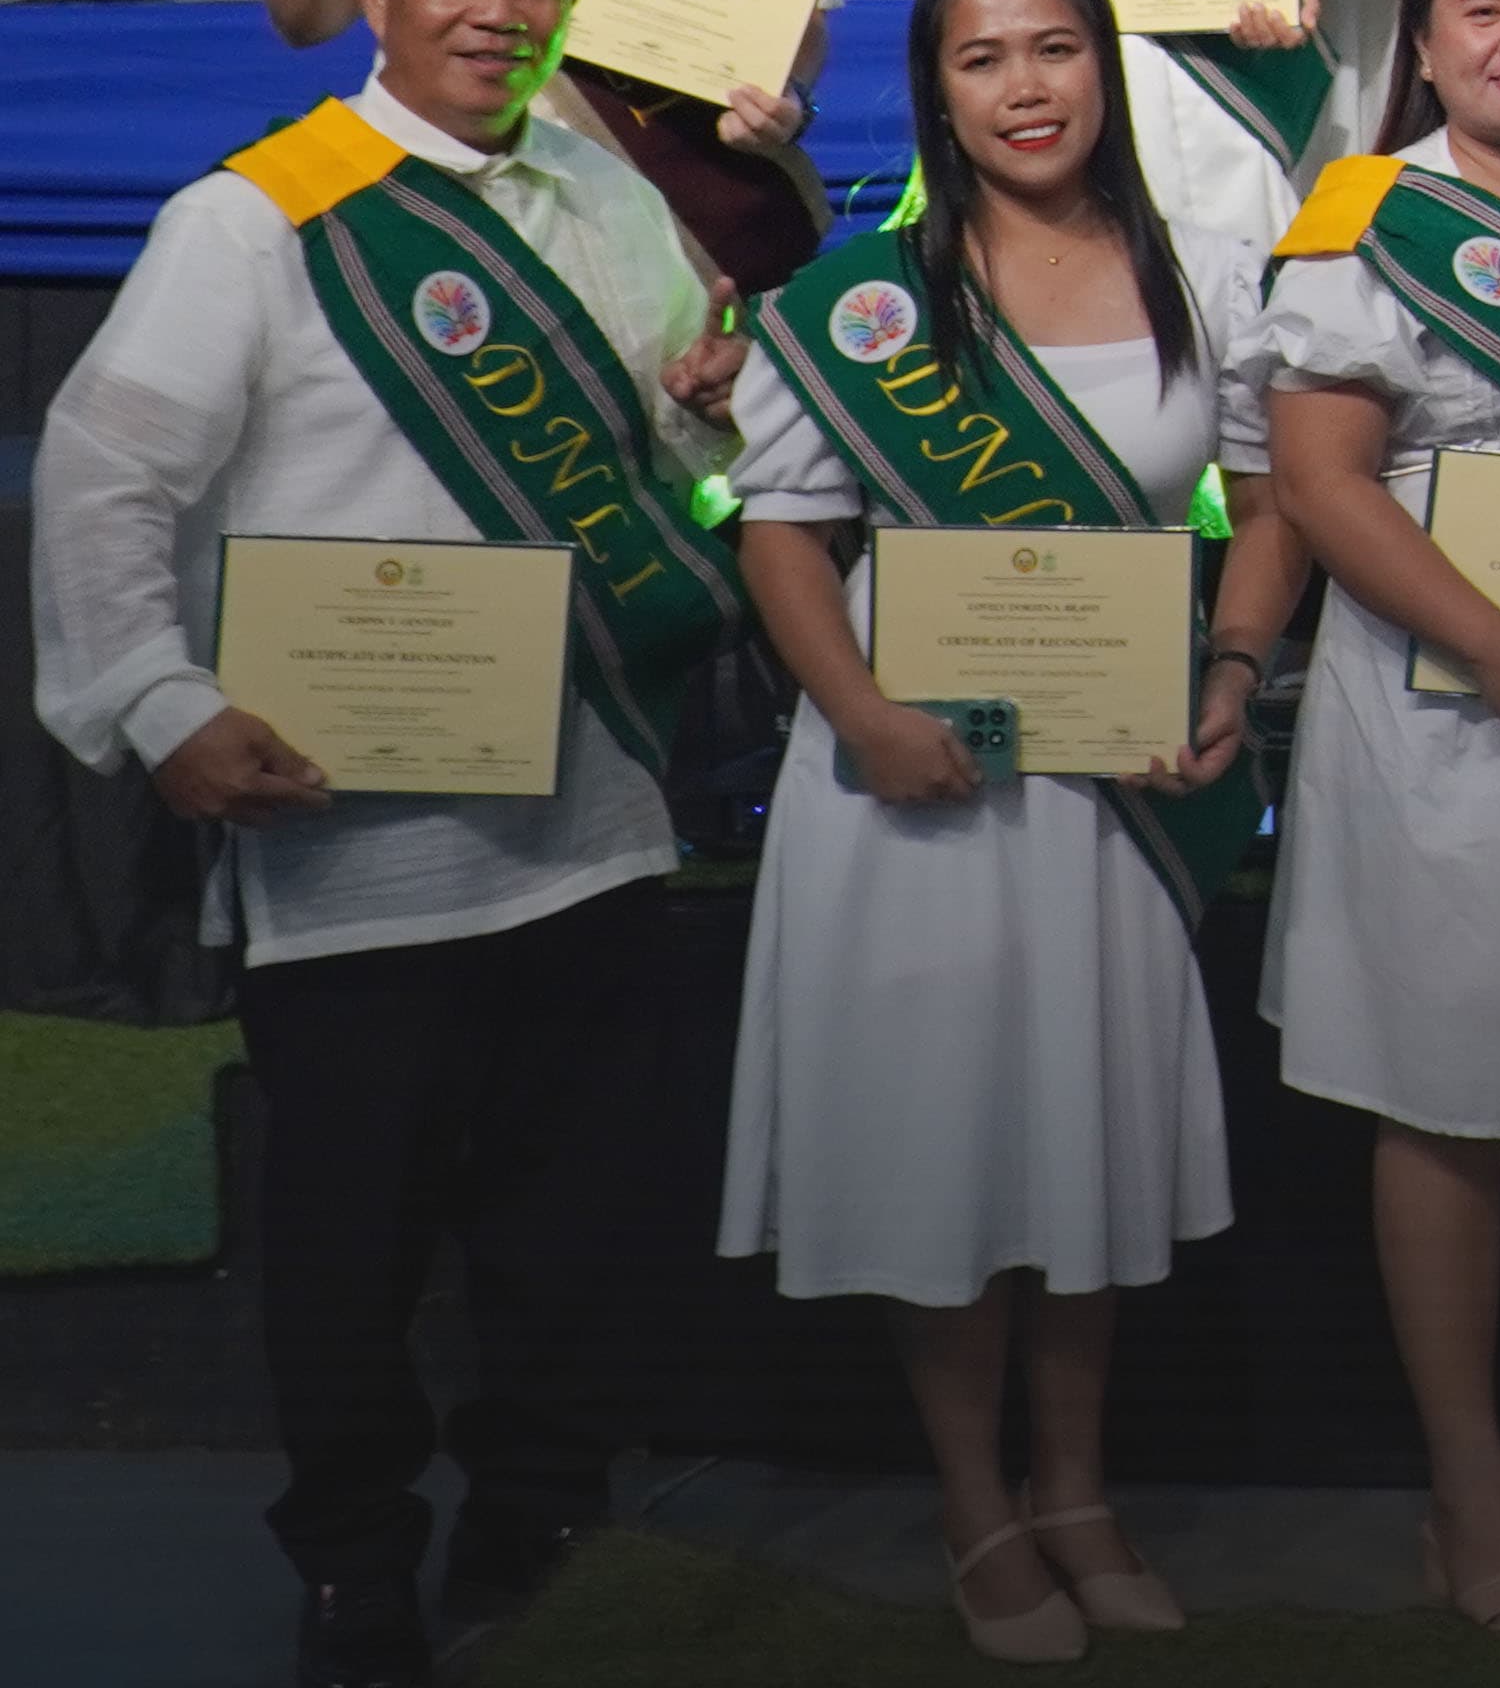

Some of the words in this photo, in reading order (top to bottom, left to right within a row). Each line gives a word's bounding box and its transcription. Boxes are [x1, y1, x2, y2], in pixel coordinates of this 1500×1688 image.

[464, 343, 665, 607] DNLI
[936, 636, 1018, 648] CERTIFICATE
[1039, 636, 1128, 649] RECOGNITION
